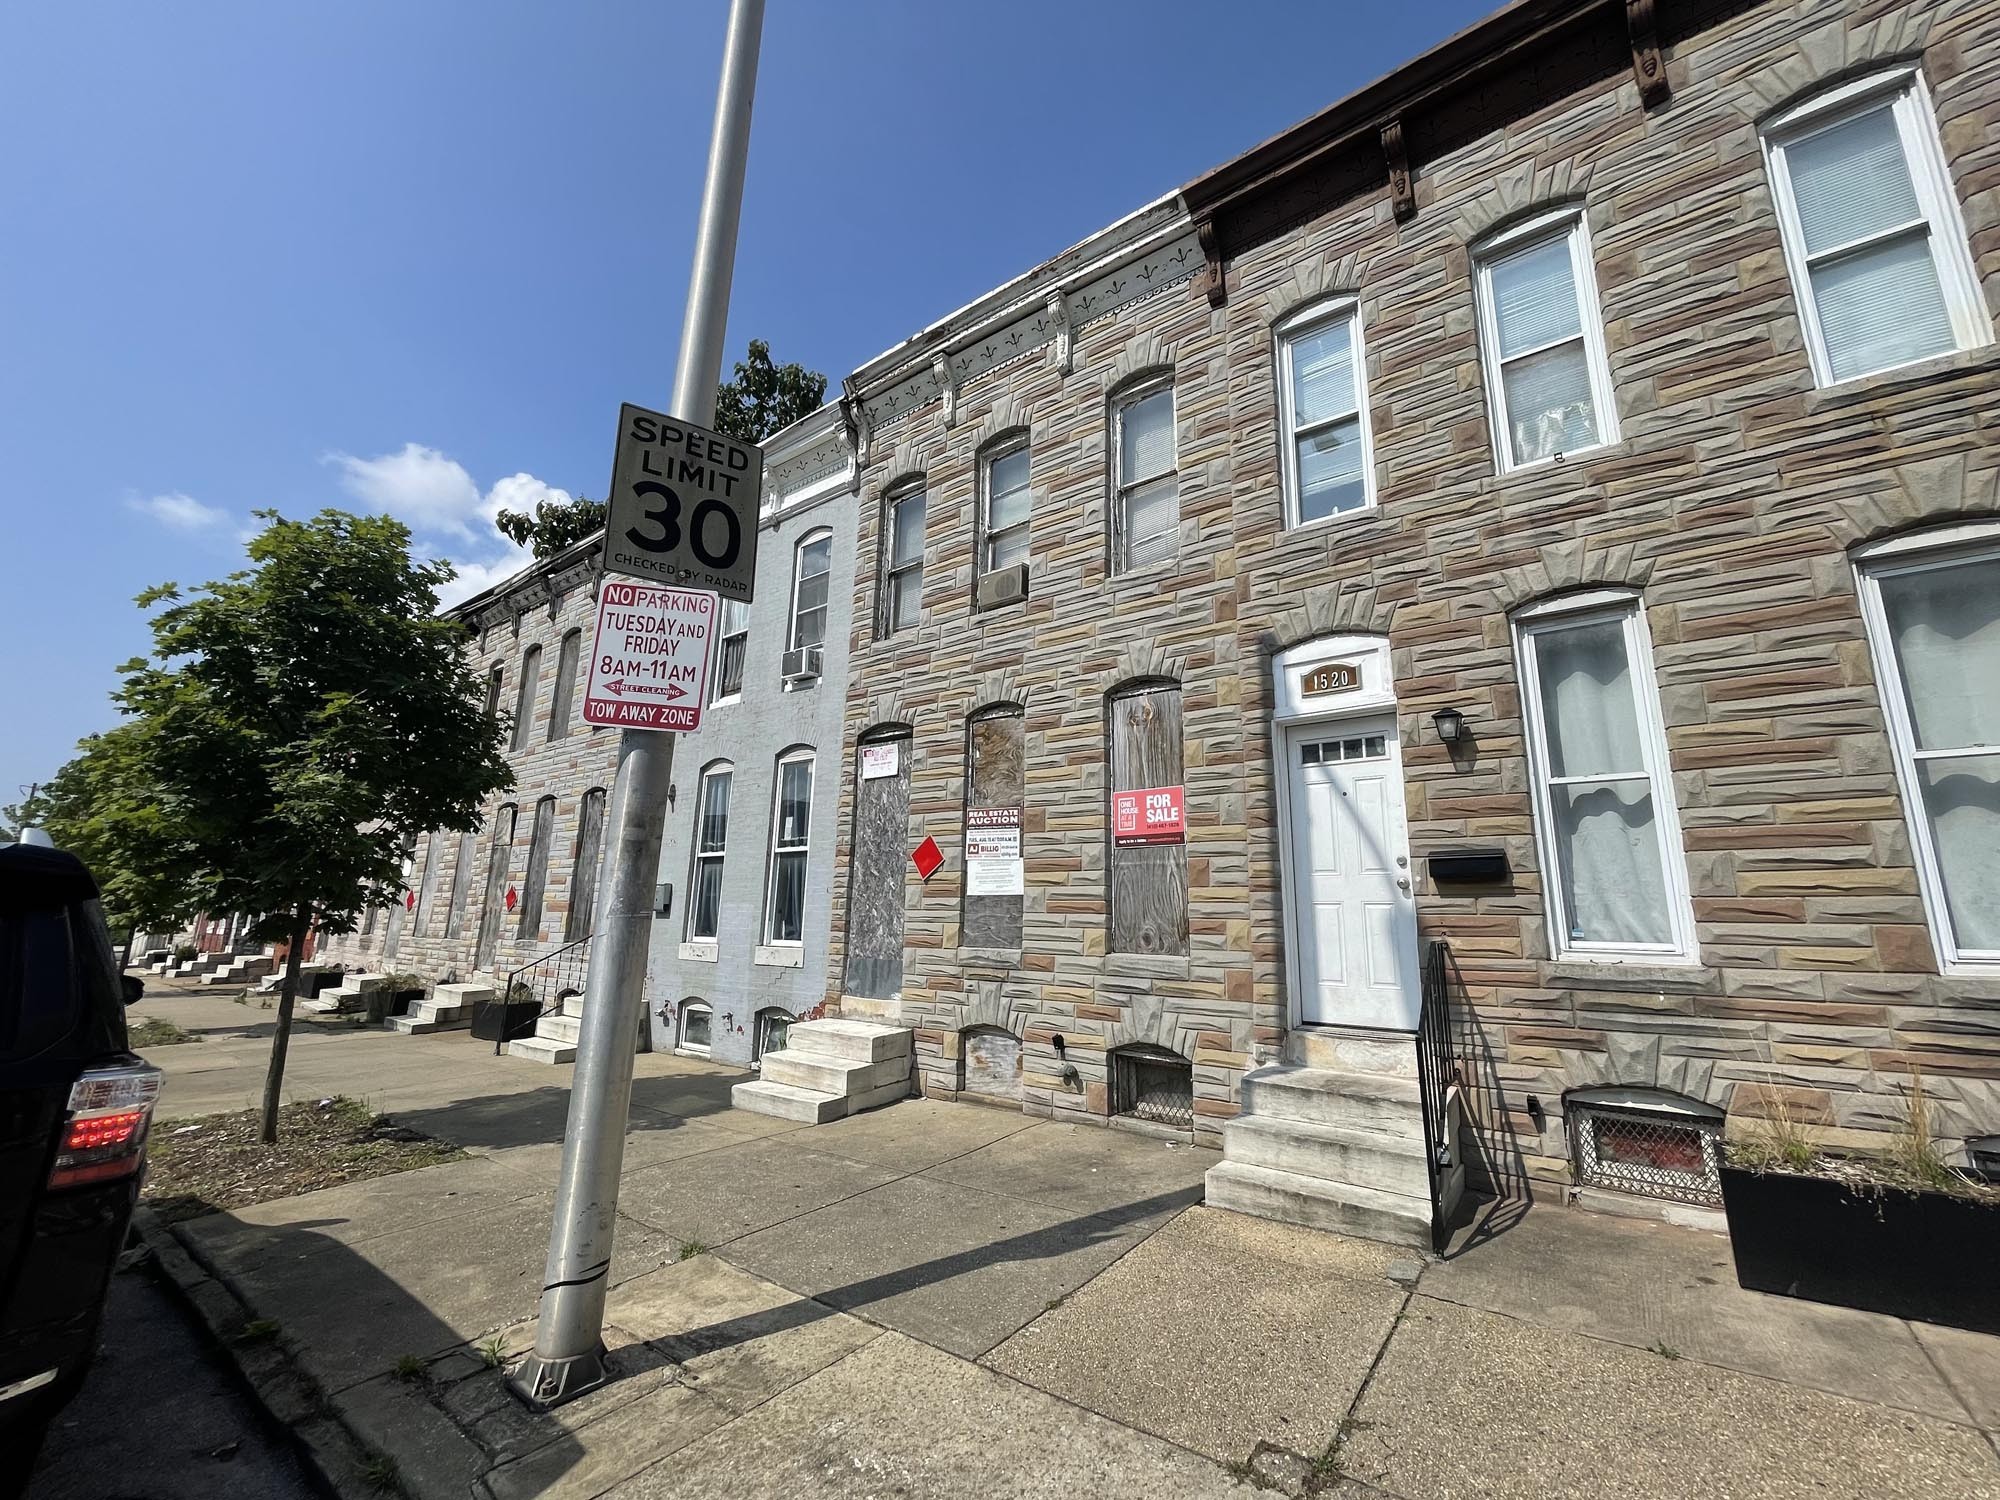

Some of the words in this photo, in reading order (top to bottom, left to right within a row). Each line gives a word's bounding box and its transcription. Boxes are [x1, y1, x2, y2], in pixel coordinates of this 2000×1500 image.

[630, 416, 749, 471] SPEED
[642, 450, 739, 497] LIMIT
[625, 480, 741, 570] 30
[614, 553, 675, 576] CHECKED
[682, 569, 699, 581] BY
[704, 574, 748, 593] RADAR
[607, 585, 632, 605] NO
[637, 591, 709, 614] PARKING
[607, 612, 677, 636] TUESDAY
[677, 623, 705, 639] AND
[624, 635, 680, 657] FRIDAY
[600, 655, 697, 683] 8AM-11AM
[1313, 670, 1349, 690] 1520
[610, 683, 641, 693] STREET
[641, 685, 681, 696] CLEANING
[590, 702, 616, 719] TOW
[619, 704, 657, 722] AWAY
[660, 708, 695, 726] ZONE
[1120, 807, 1139, 815] HOUSE
[1146, 793, 1171, 809] FOR
[969, 816, 1019, 825] AUCTION
[989, 809, 1019, 817] ESTATE
[1146, 807, 1179, 823] SALE
